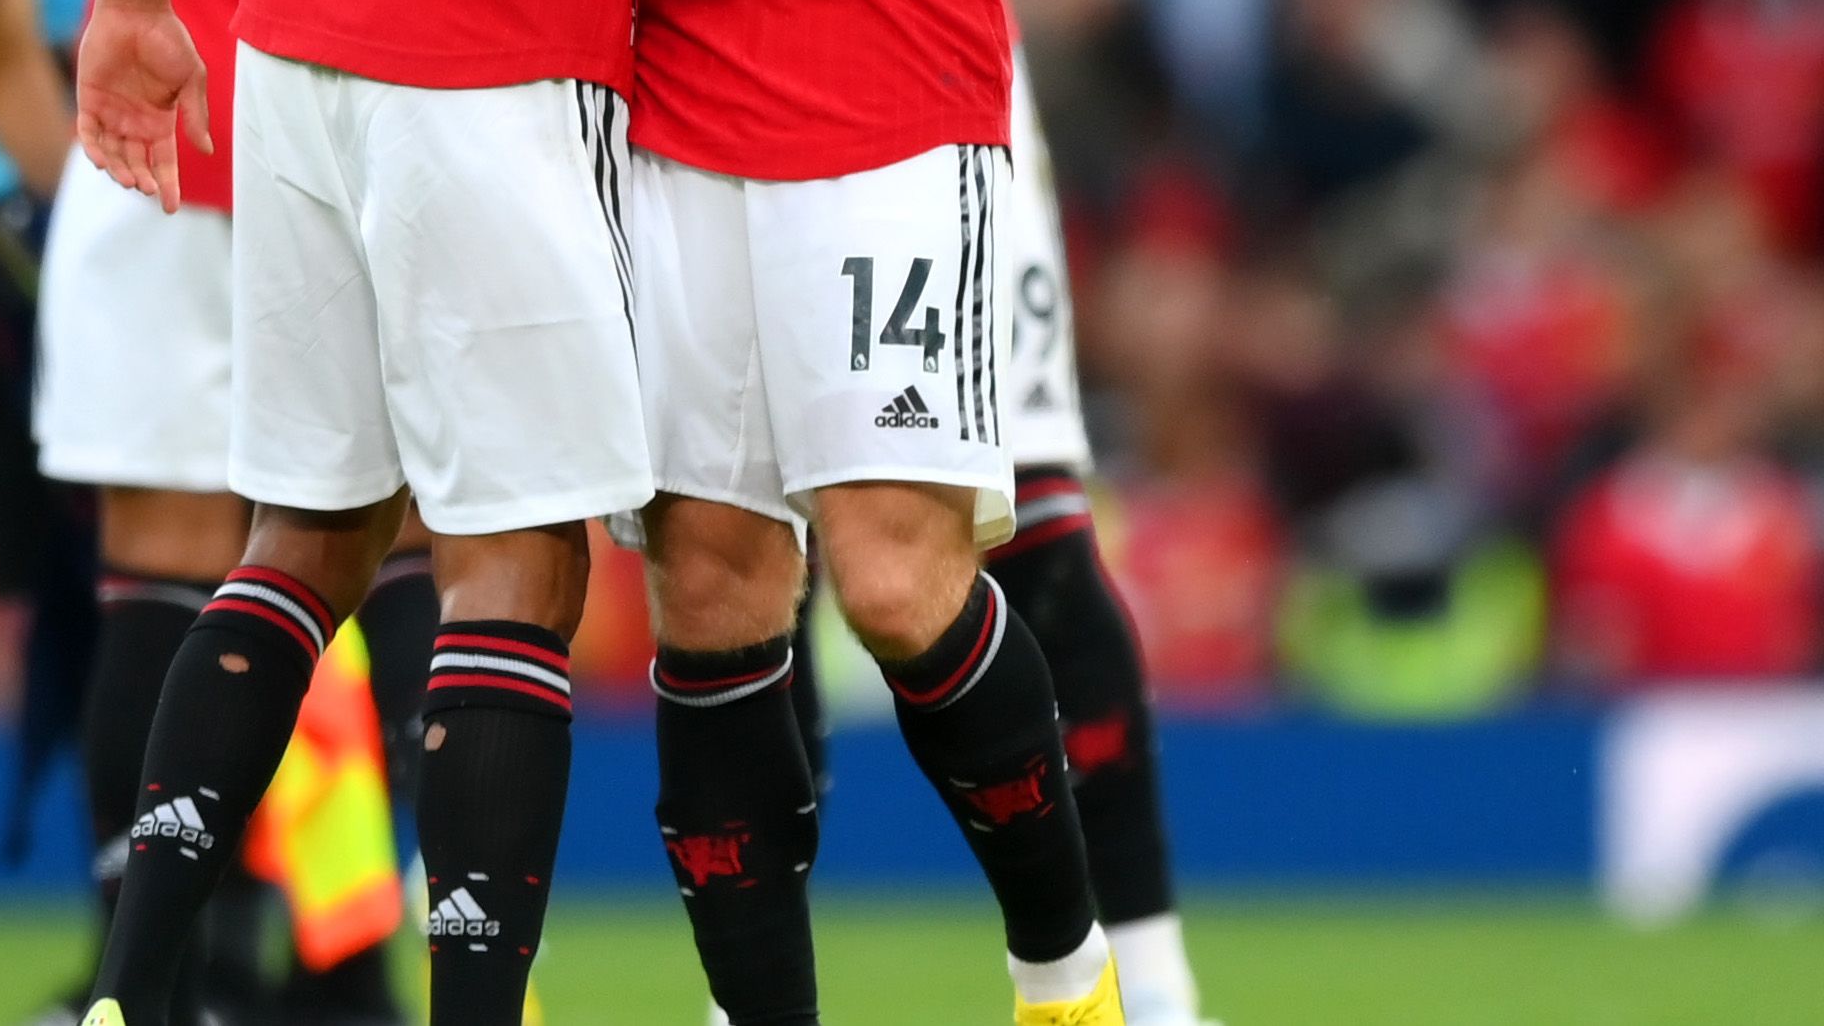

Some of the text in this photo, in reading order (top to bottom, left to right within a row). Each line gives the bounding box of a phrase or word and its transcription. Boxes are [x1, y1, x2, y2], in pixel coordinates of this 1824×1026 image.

[840, 256, 947, 374] 14
[1011, 265, 1058, 366] 9
[874, 411, 940, 429] adidas
[130, 821, 216, 850] adidas
